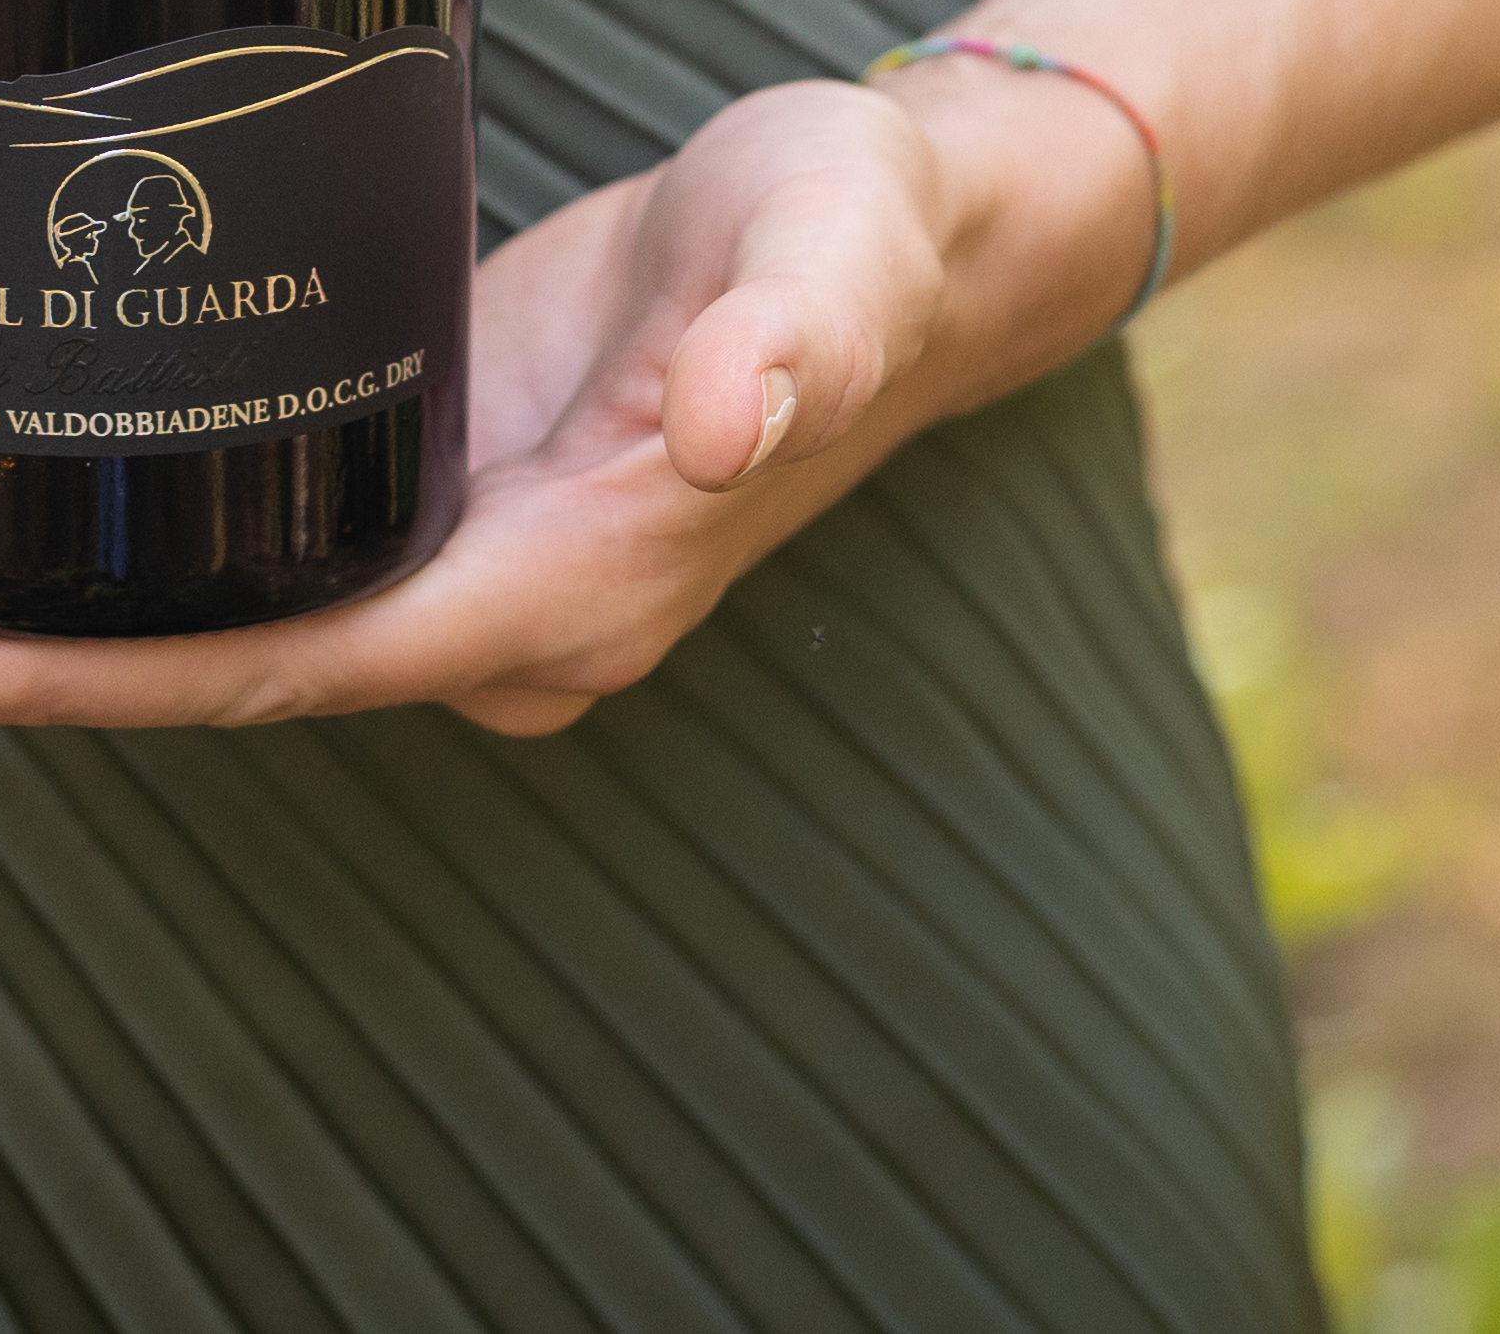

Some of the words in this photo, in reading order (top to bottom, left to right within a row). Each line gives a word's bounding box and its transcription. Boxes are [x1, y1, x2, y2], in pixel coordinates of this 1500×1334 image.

[39, 288, 98, 330] DI
[115, 266, 330, 328] GUARDA
[5, 397, 272, 437] VALDOBBIADENE
[277, 370, 381, 420] D.O.C.G.
[385, 348, 425, 389] DRY
